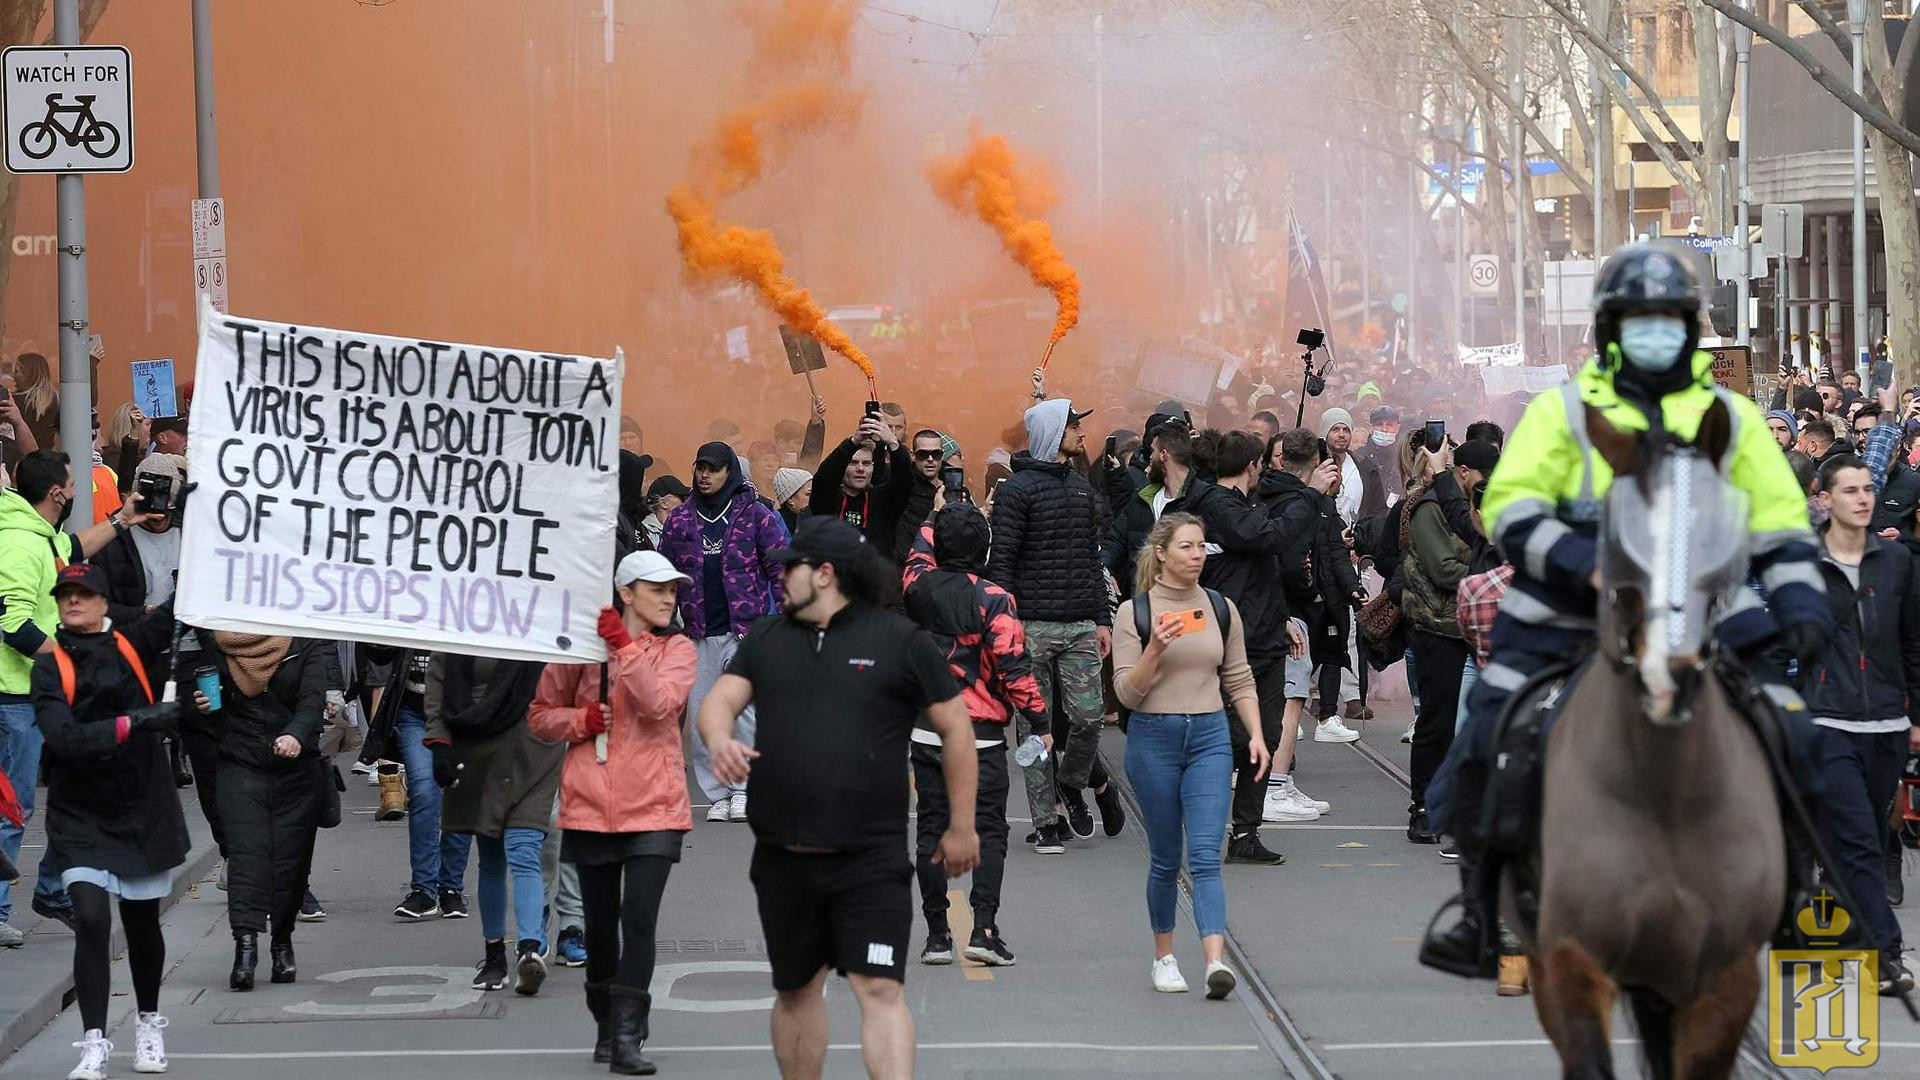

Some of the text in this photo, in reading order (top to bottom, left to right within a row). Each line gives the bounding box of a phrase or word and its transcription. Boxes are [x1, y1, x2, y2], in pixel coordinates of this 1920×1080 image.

[16, 66, 119, 82] WATCH FOR
[1474, 266, 1495, 281] 30
[134, 363, 150, 371] STAY
[334, 340, 367, 393] IS
[372, 342, 451, 400] NOT
[579, 361, 612, 409] A
[1711, 369, 1737, 379] RONG.
[1712, 351, 1725, 360] SO
[392, 401, 517, 458] ABOUT
[523, 412, 609, 472] TOTAL
[338, 449, 544, 518] CONTROL
[218, 489, 560, 581] OF THE PEOPLE
[214, 548, 304, 612] THIS
[312, 561, 430, 623] STOPS
[438, 578, 540, 638] NOW
